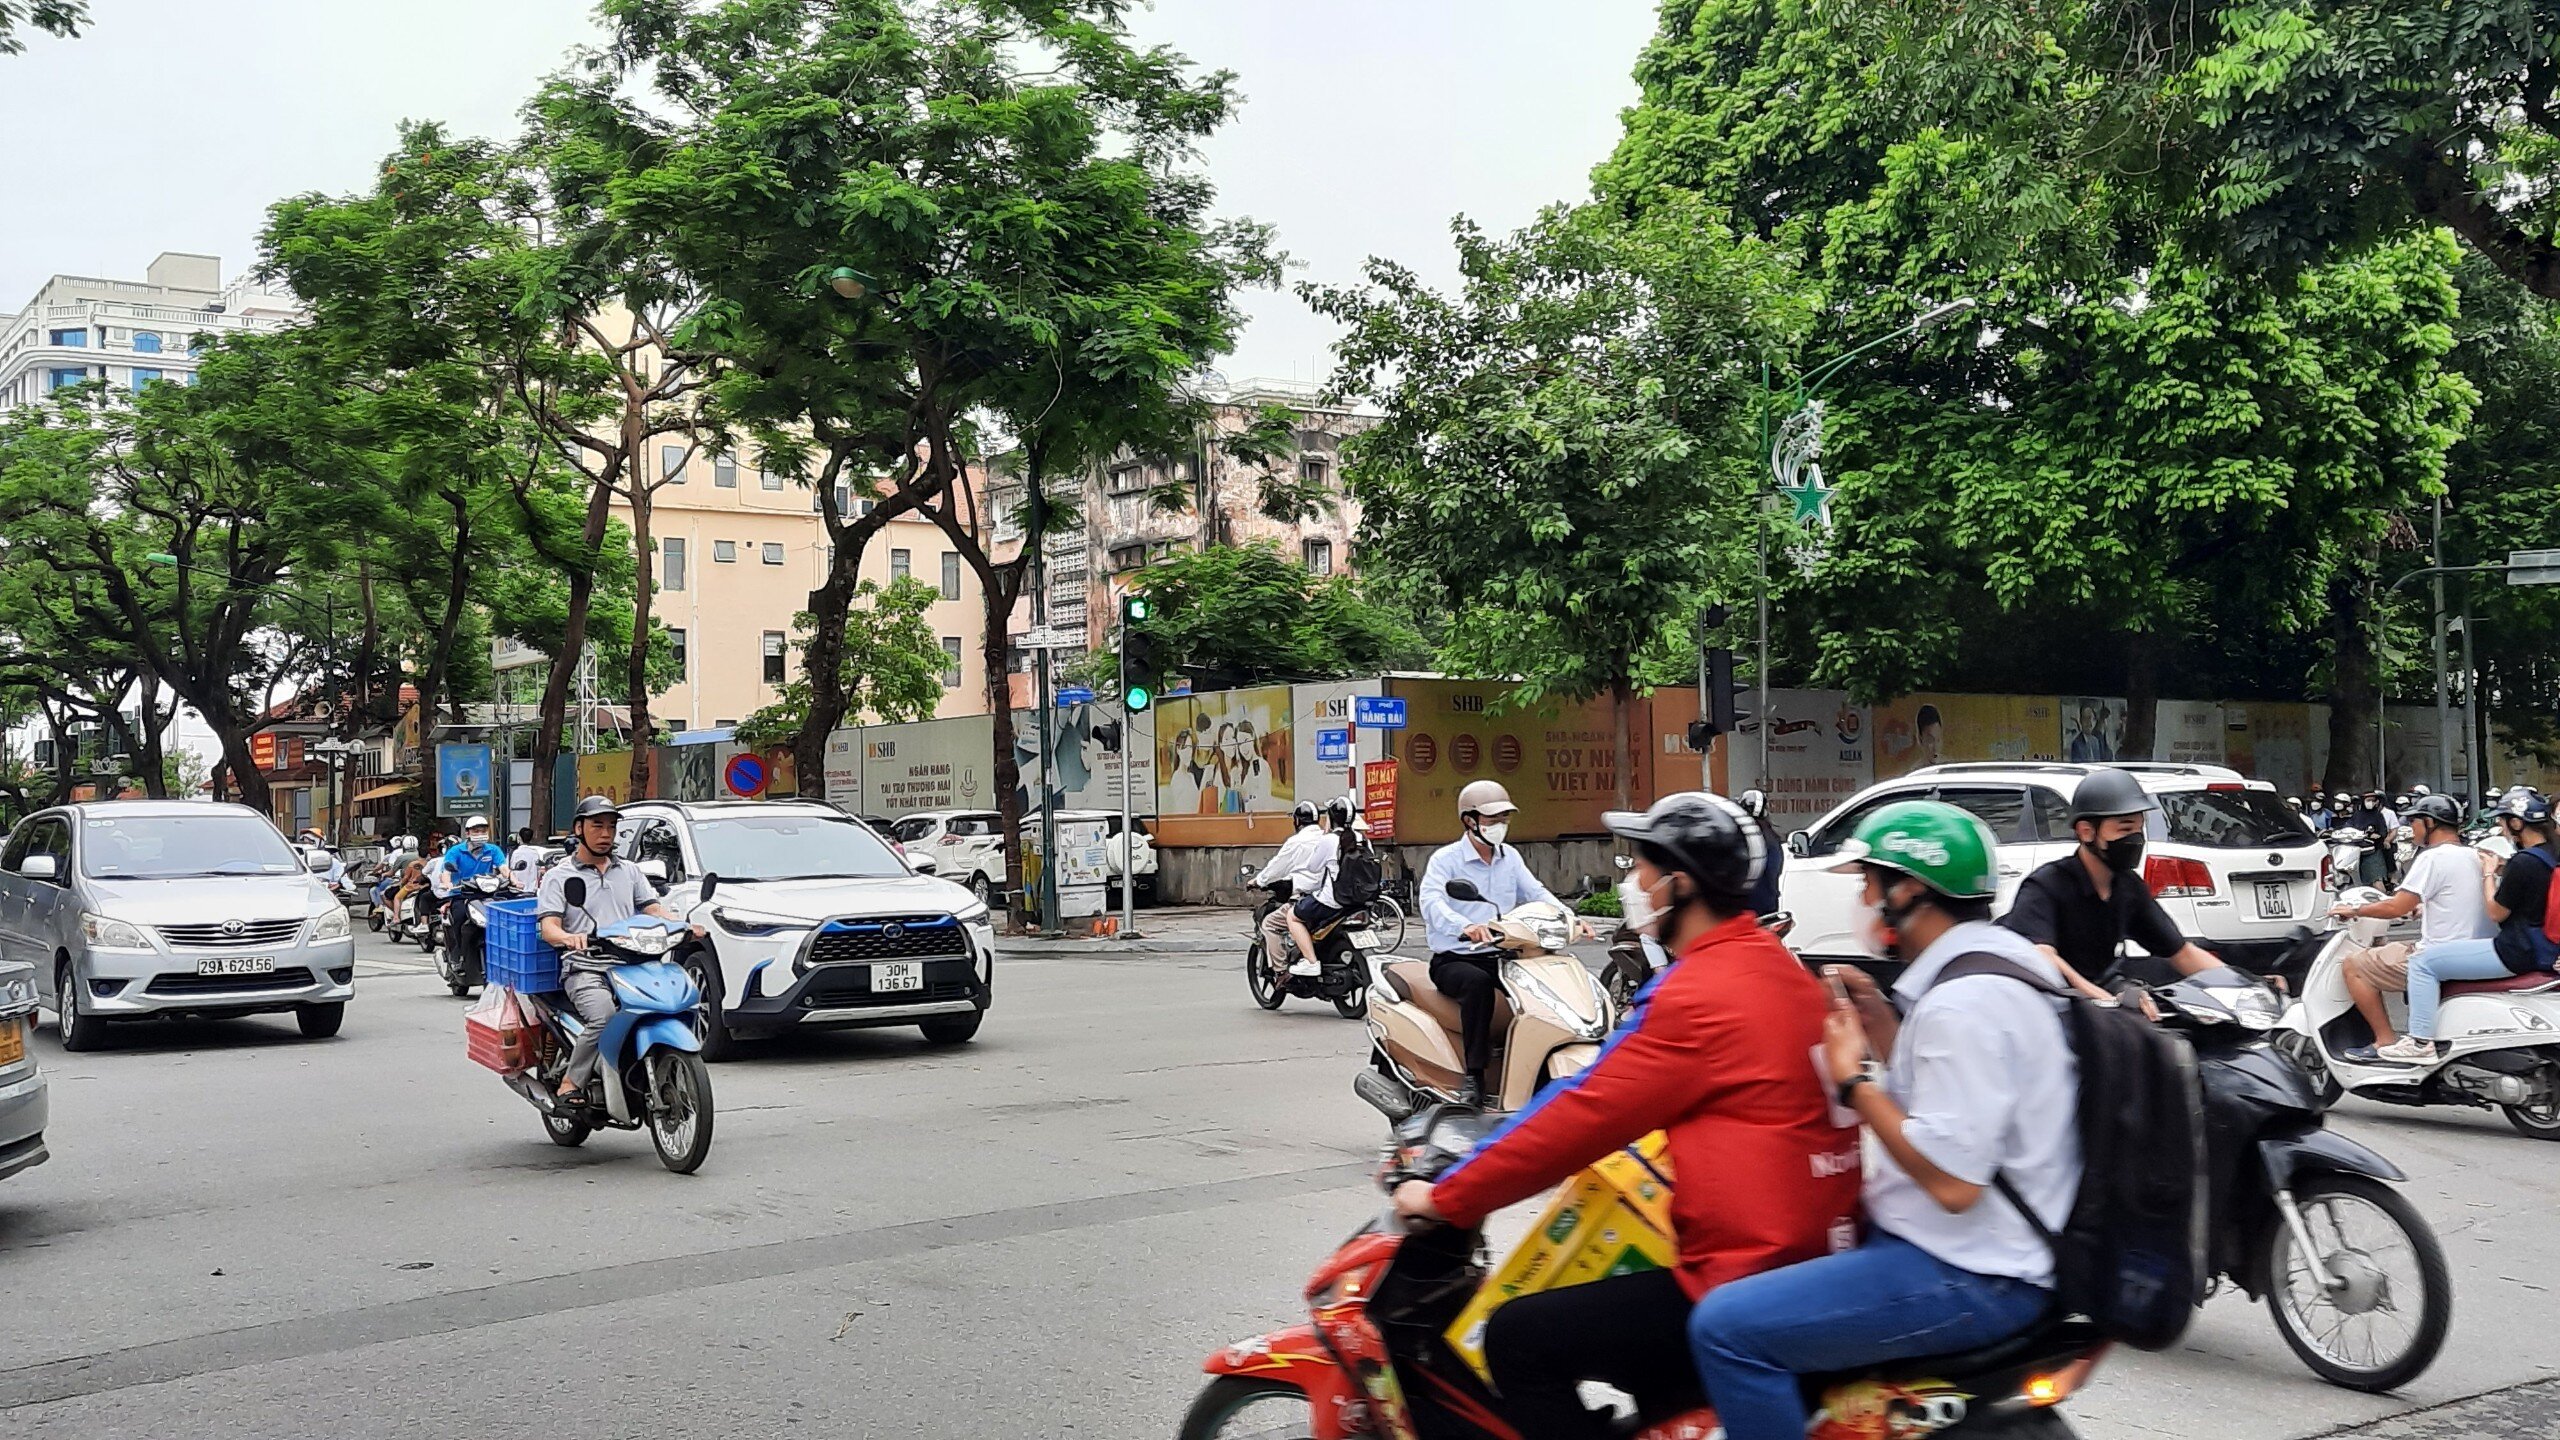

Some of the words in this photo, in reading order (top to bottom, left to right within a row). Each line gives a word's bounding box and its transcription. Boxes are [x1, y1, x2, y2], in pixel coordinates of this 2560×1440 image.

[1328, 699, 1347, 717] SH
[1453, 695, 1483, 712] SHB
[1362, 709, 1386, 723] HÀNG
[1387, 709, 1403, 723] BÀI
[877, 741, 896, 759] SHB
[1590, 749, 1640, 767] NHT
[1546, 769, 1588, 795] VIỆT
[2264, 901, 2286, 915] 1404
[886, 964, 909, 977] 30H
[878, 976, 918, 990] 136.67
